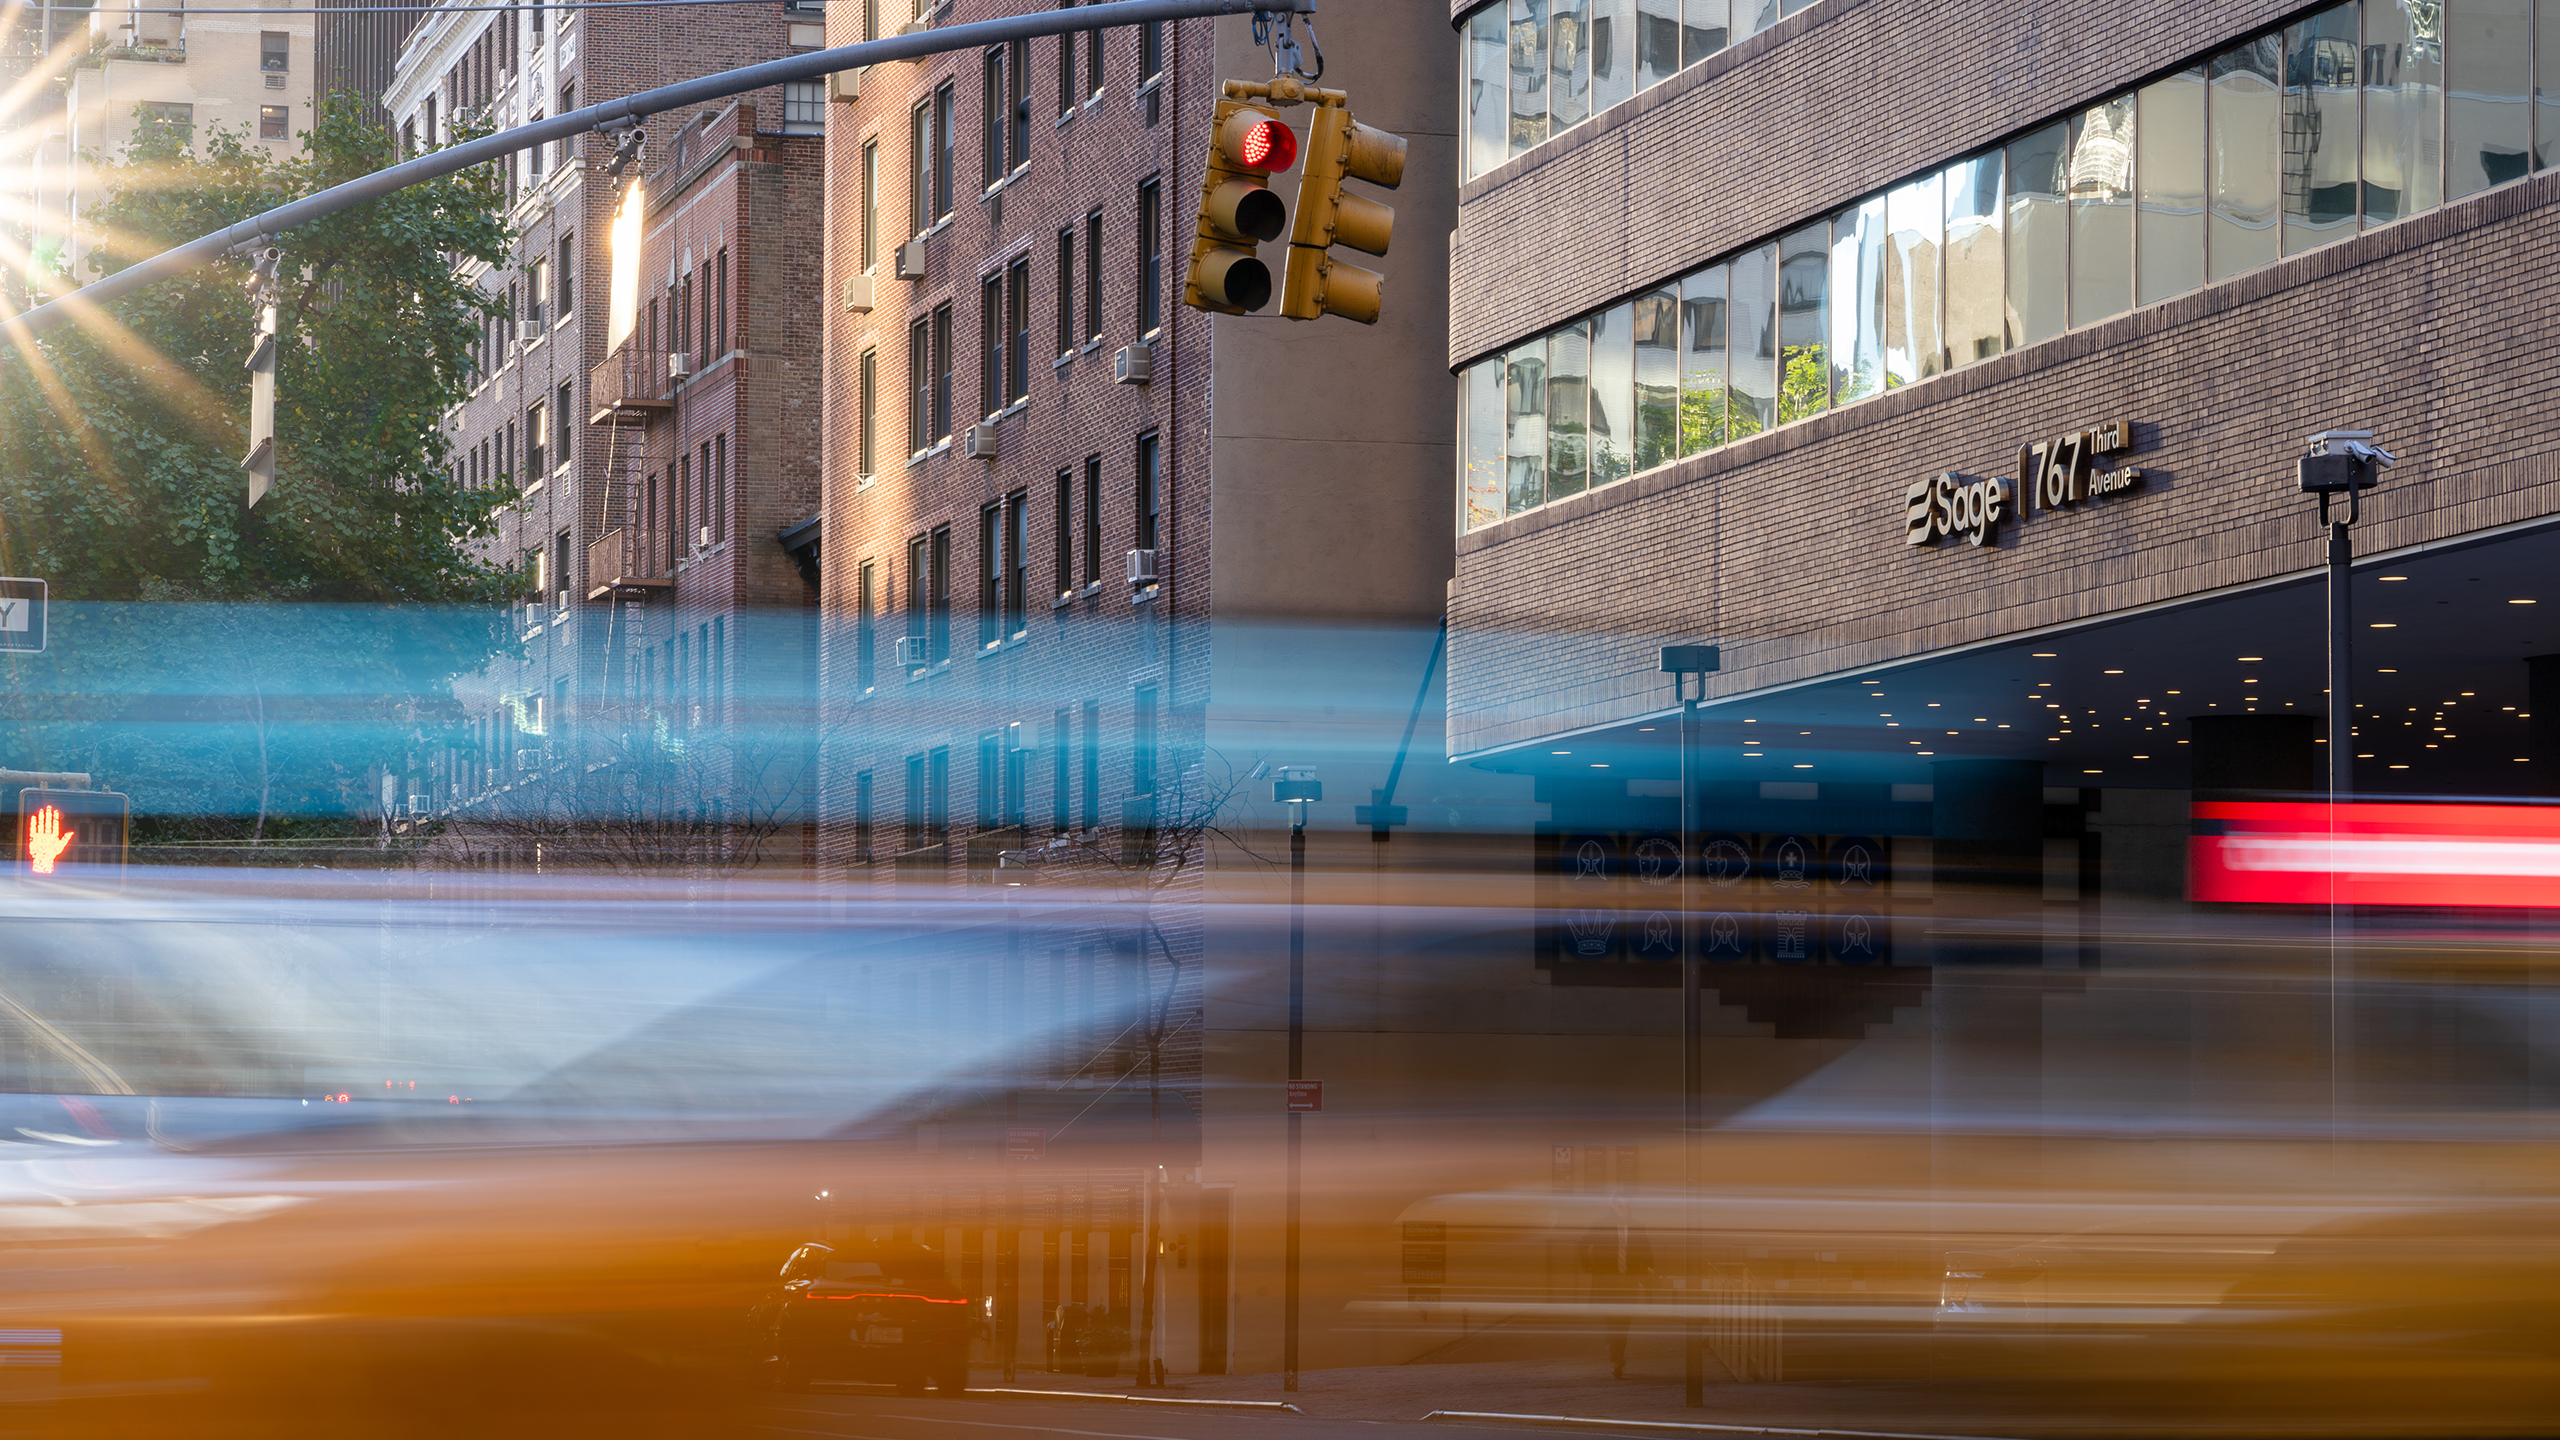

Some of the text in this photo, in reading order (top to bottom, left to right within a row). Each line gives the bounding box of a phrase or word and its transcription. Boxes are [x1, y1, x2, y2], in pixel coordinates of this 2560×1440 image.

[2088, 420, 2121, 456] Third
[1936, 431, 2083, 547] Sage 767
[2088, 466, 2132, 496] Avenue
[1289, 1090, 1307, 1098] Anytime
